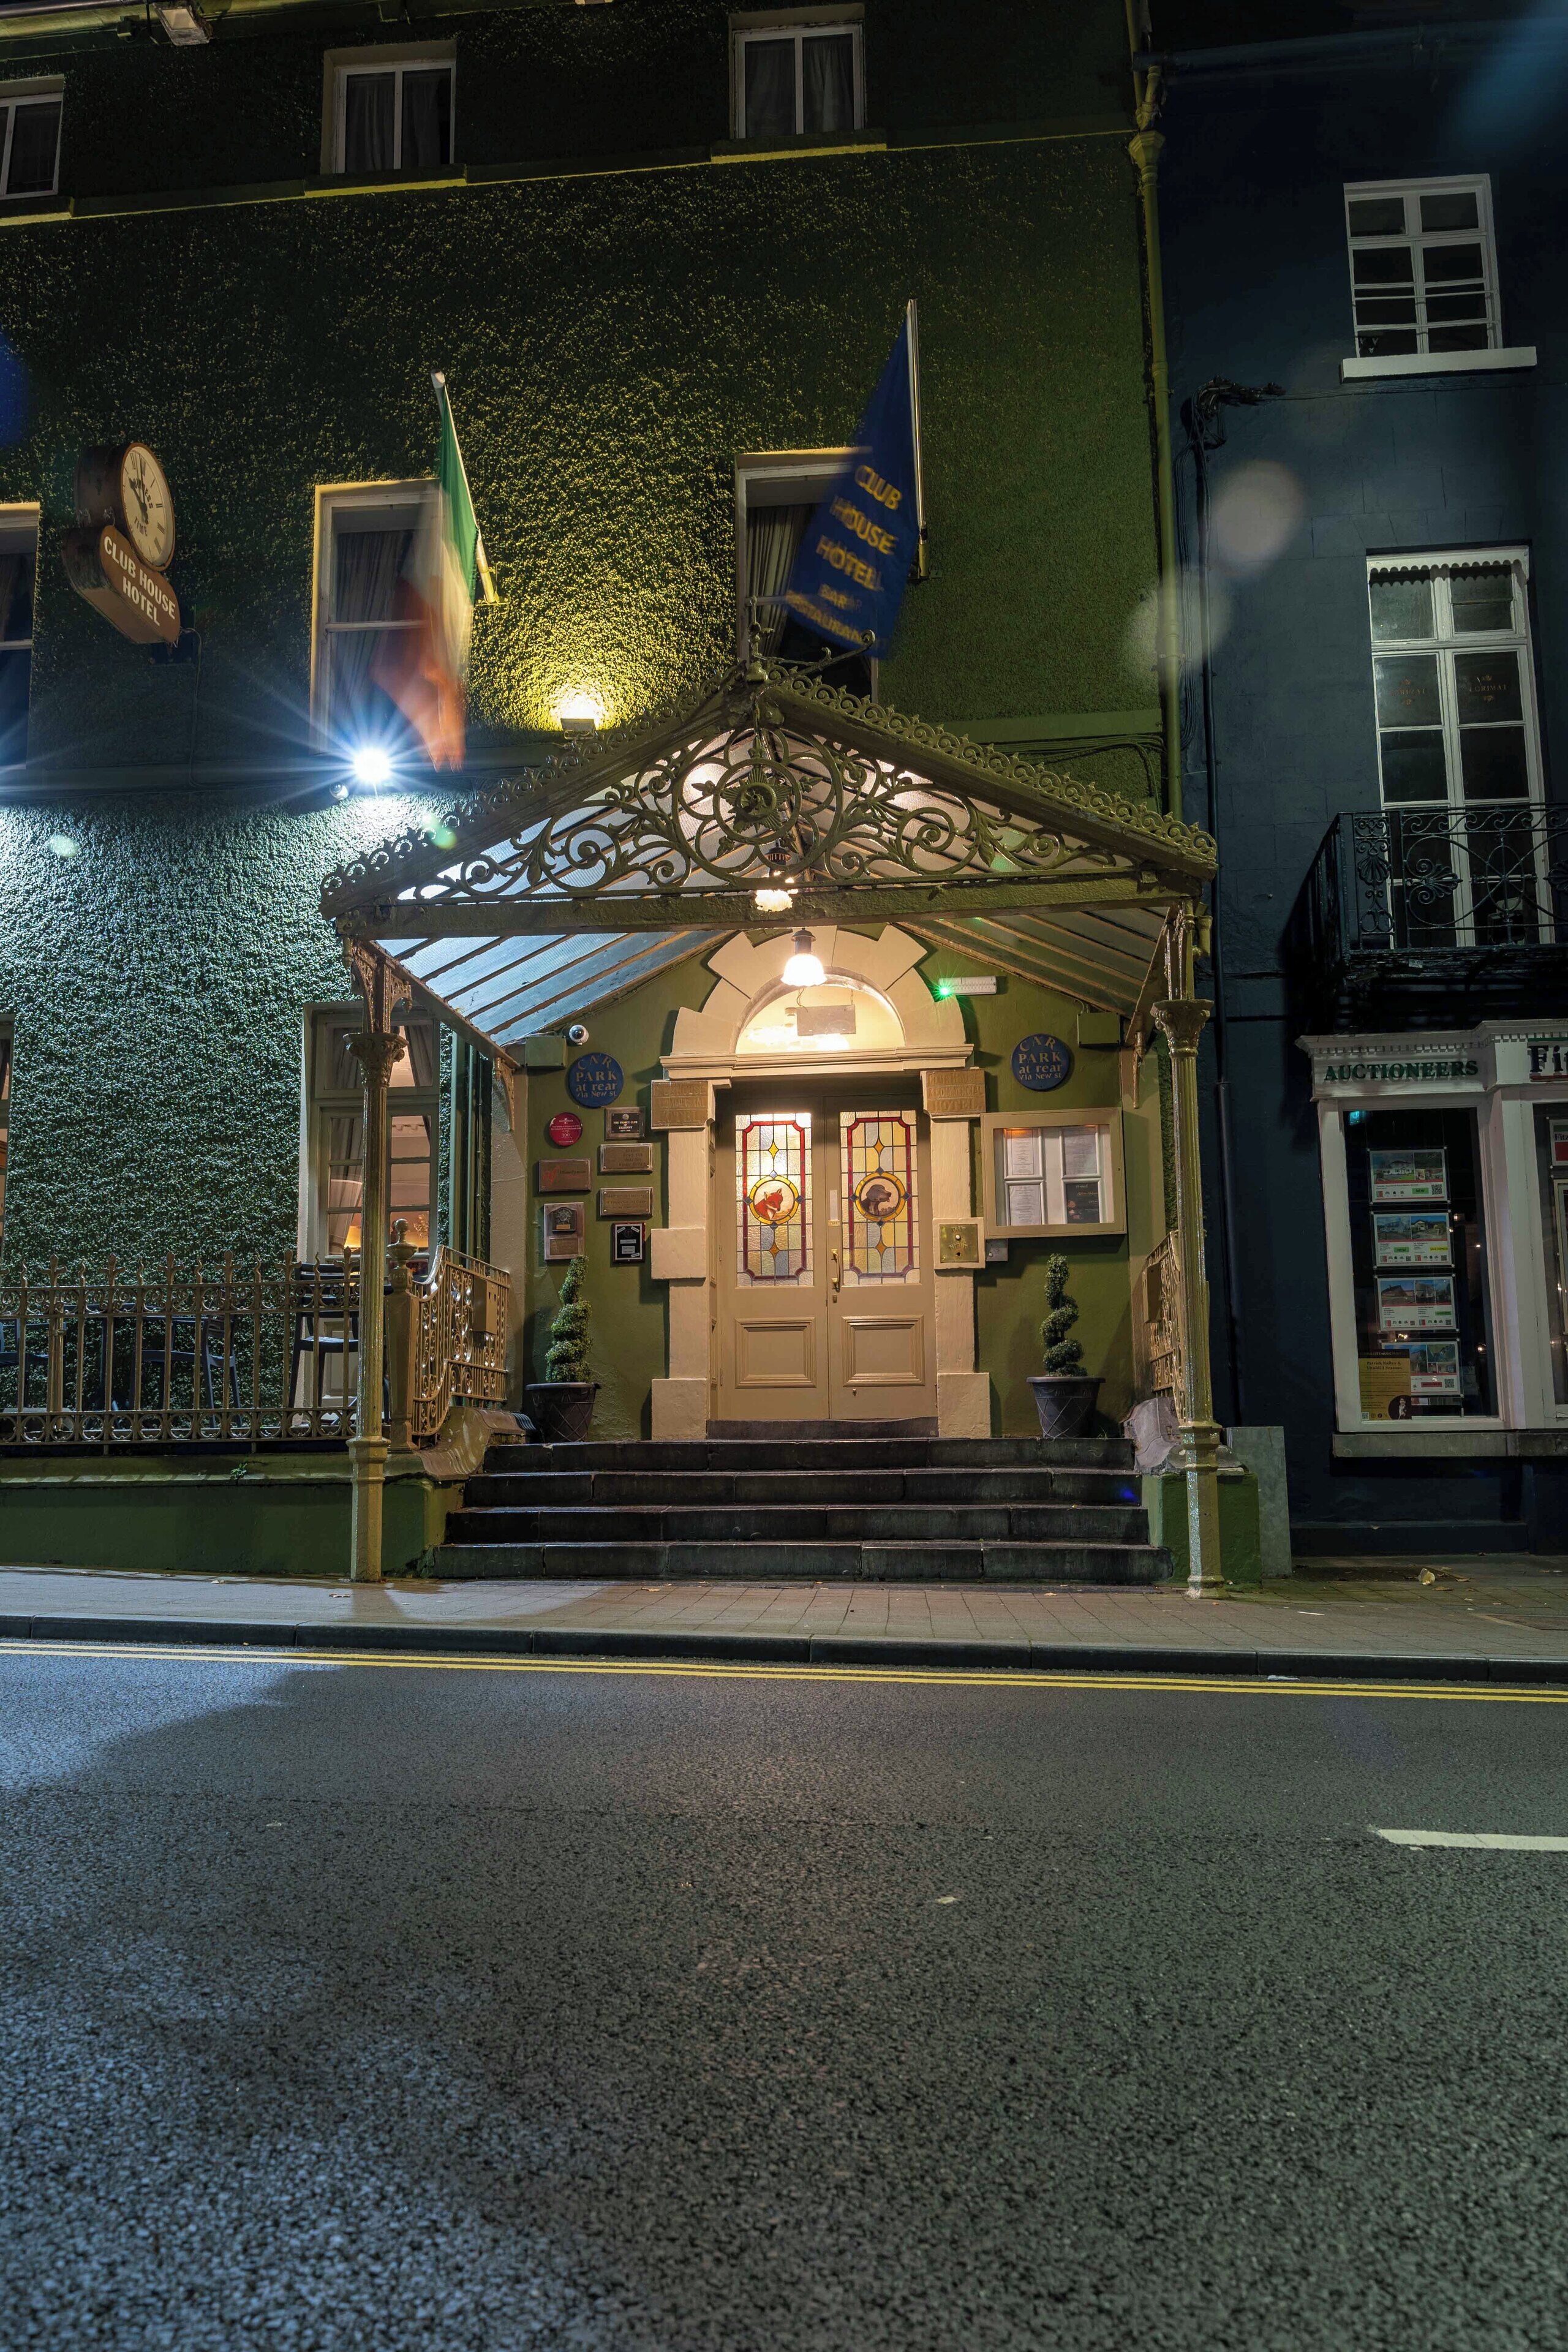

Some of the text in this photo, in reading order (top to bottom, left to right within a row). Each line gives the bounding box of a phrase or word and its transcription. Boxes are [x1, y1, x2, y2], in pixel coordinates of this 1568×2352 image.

[855, 465, 902, 510] CLUB
[829, 496, 897, 554] HOUSE
[816, 535, 884, 591] HOTEL
[104, 536, 176, 620] CLUB HOUSE
[123, 576, 160, 626] HOTEL
[1020, 1036, 1056, 1052] CAR
[578, 1055, 612, 1070] CAR
[1019, 1052, 1061, 1064] PARK
[576, 1071, 617, 1082] PARK
[1036, 1065, 1061, 1073] rear
[1324, 1060, 1478, 1081] AUCTIONEERS
